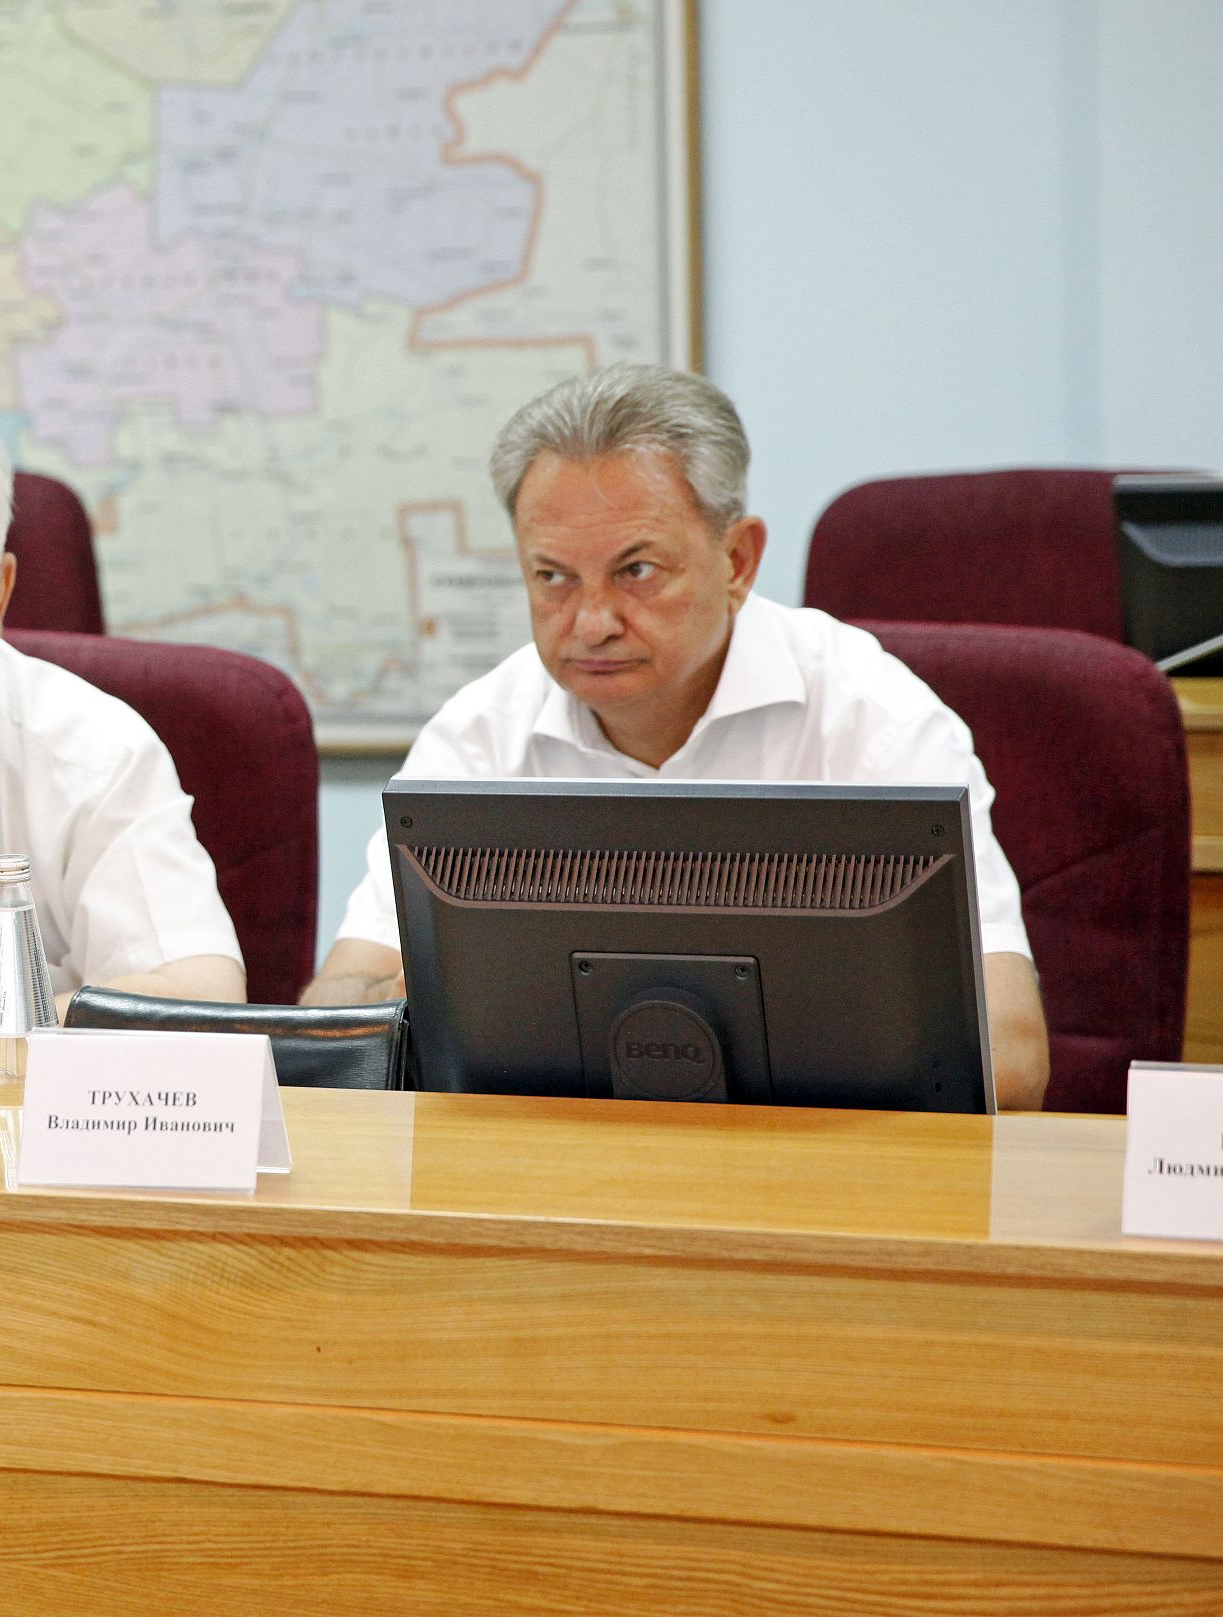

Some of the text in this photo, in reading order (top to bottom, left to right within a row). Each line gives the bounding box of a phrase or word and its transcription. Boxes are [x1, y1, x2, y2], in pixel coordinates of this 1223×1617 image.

[625, 1041, 706, 1064] BenQ
[88, 1090, 197, 1107] ТРУХАЧЕВ
[47, 1114, 235, 1135] Владимир Иванович
